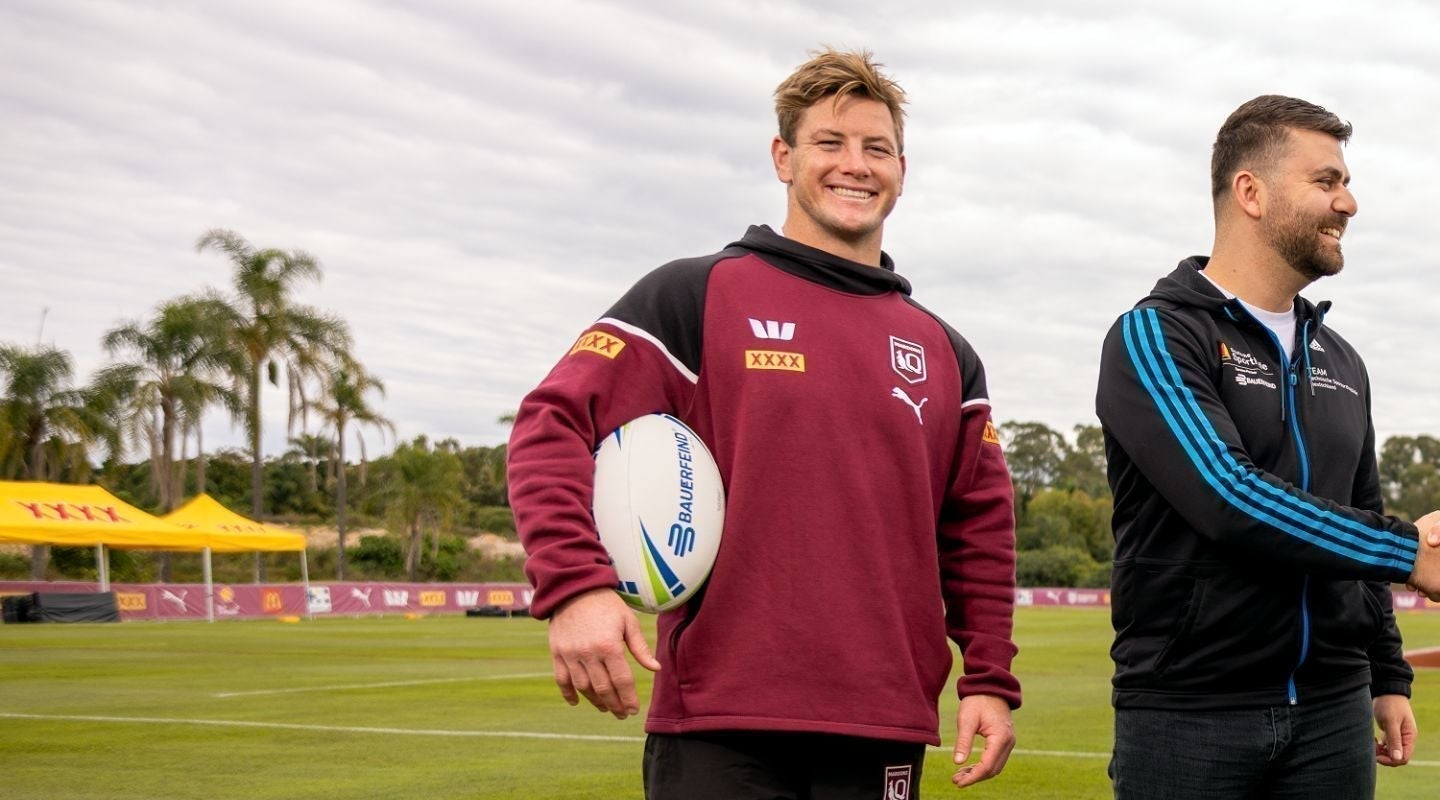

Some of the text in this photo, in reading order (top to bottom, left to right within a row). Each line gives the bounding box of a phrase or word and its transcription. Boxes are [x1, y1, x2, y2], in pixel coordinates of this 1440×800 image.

[751, 353, 800, 368] XXXX
[675, 432, 694, 523] BAUERFEIND
[16, 501, 132, 523] XXXX
